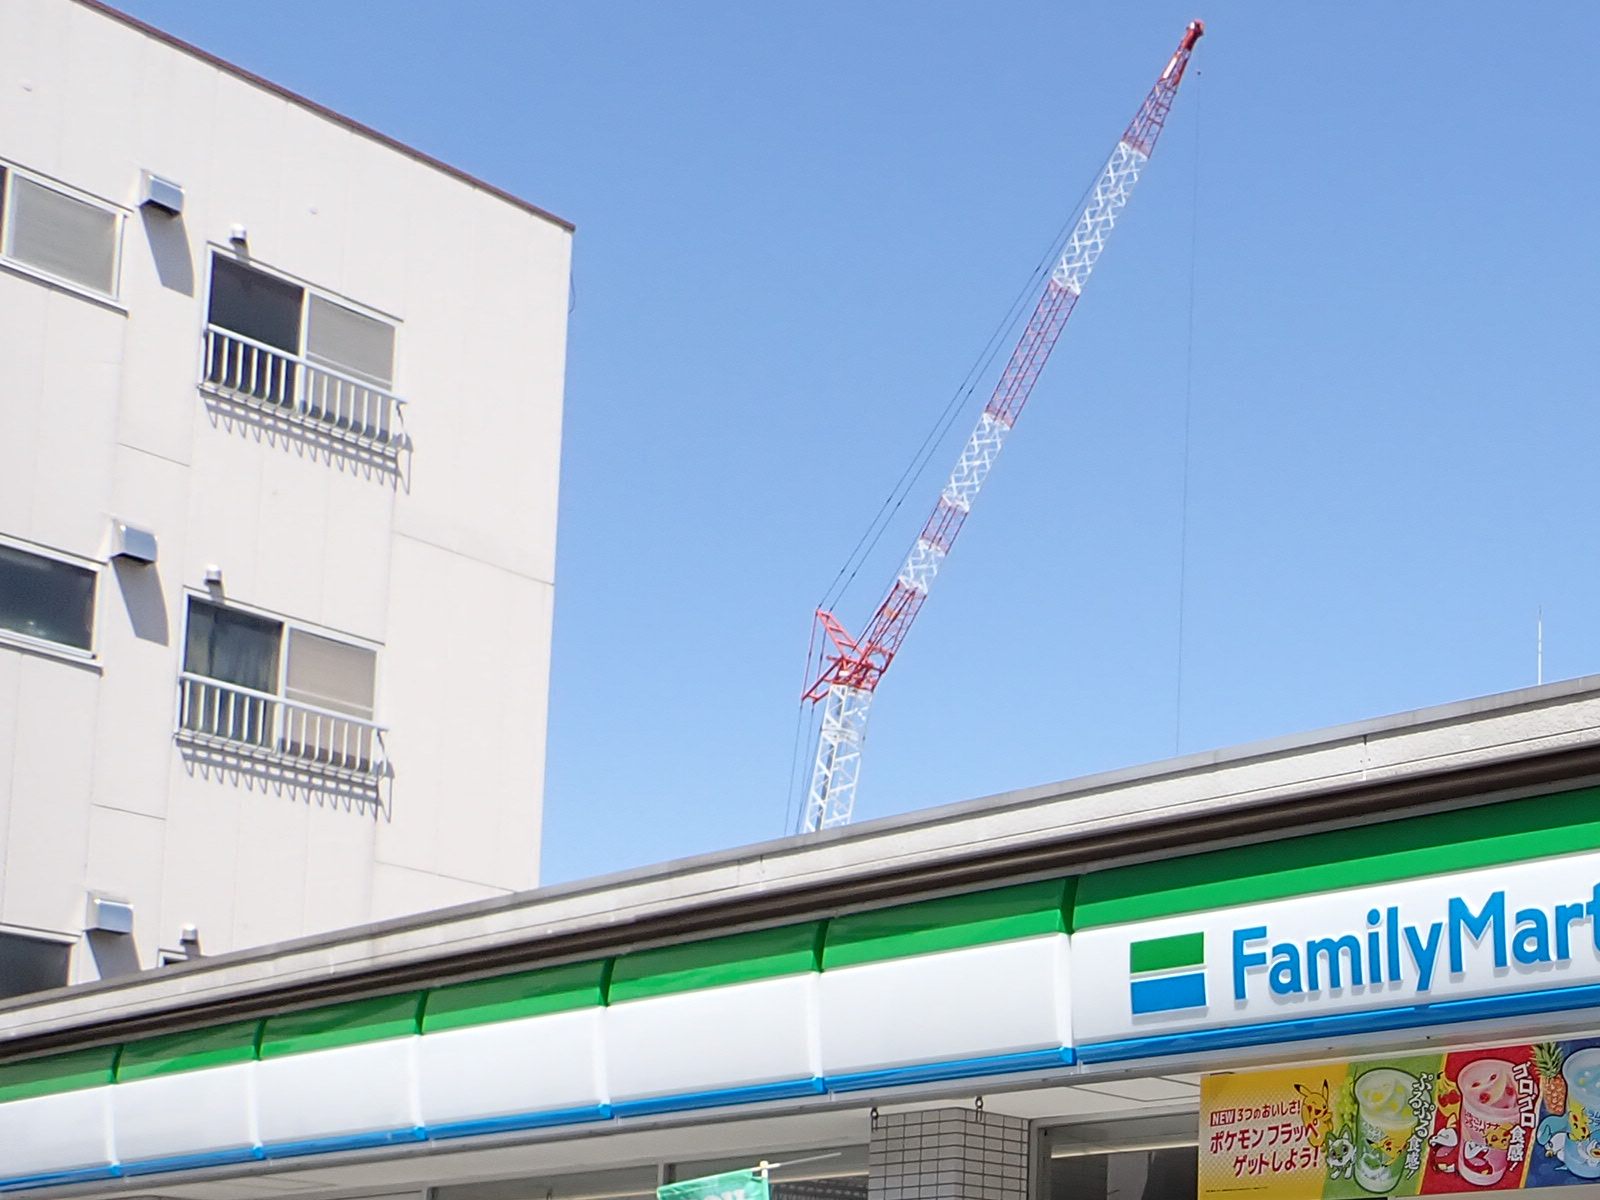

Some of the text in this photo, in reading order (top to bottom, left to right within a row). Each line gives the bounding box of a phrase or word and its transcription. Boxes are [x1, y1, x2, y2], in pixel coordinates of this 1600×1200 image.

[1211, 1109, 1235, 1126] NEW
[1233, 1146, 1320, 1178] ゲットしよう!
